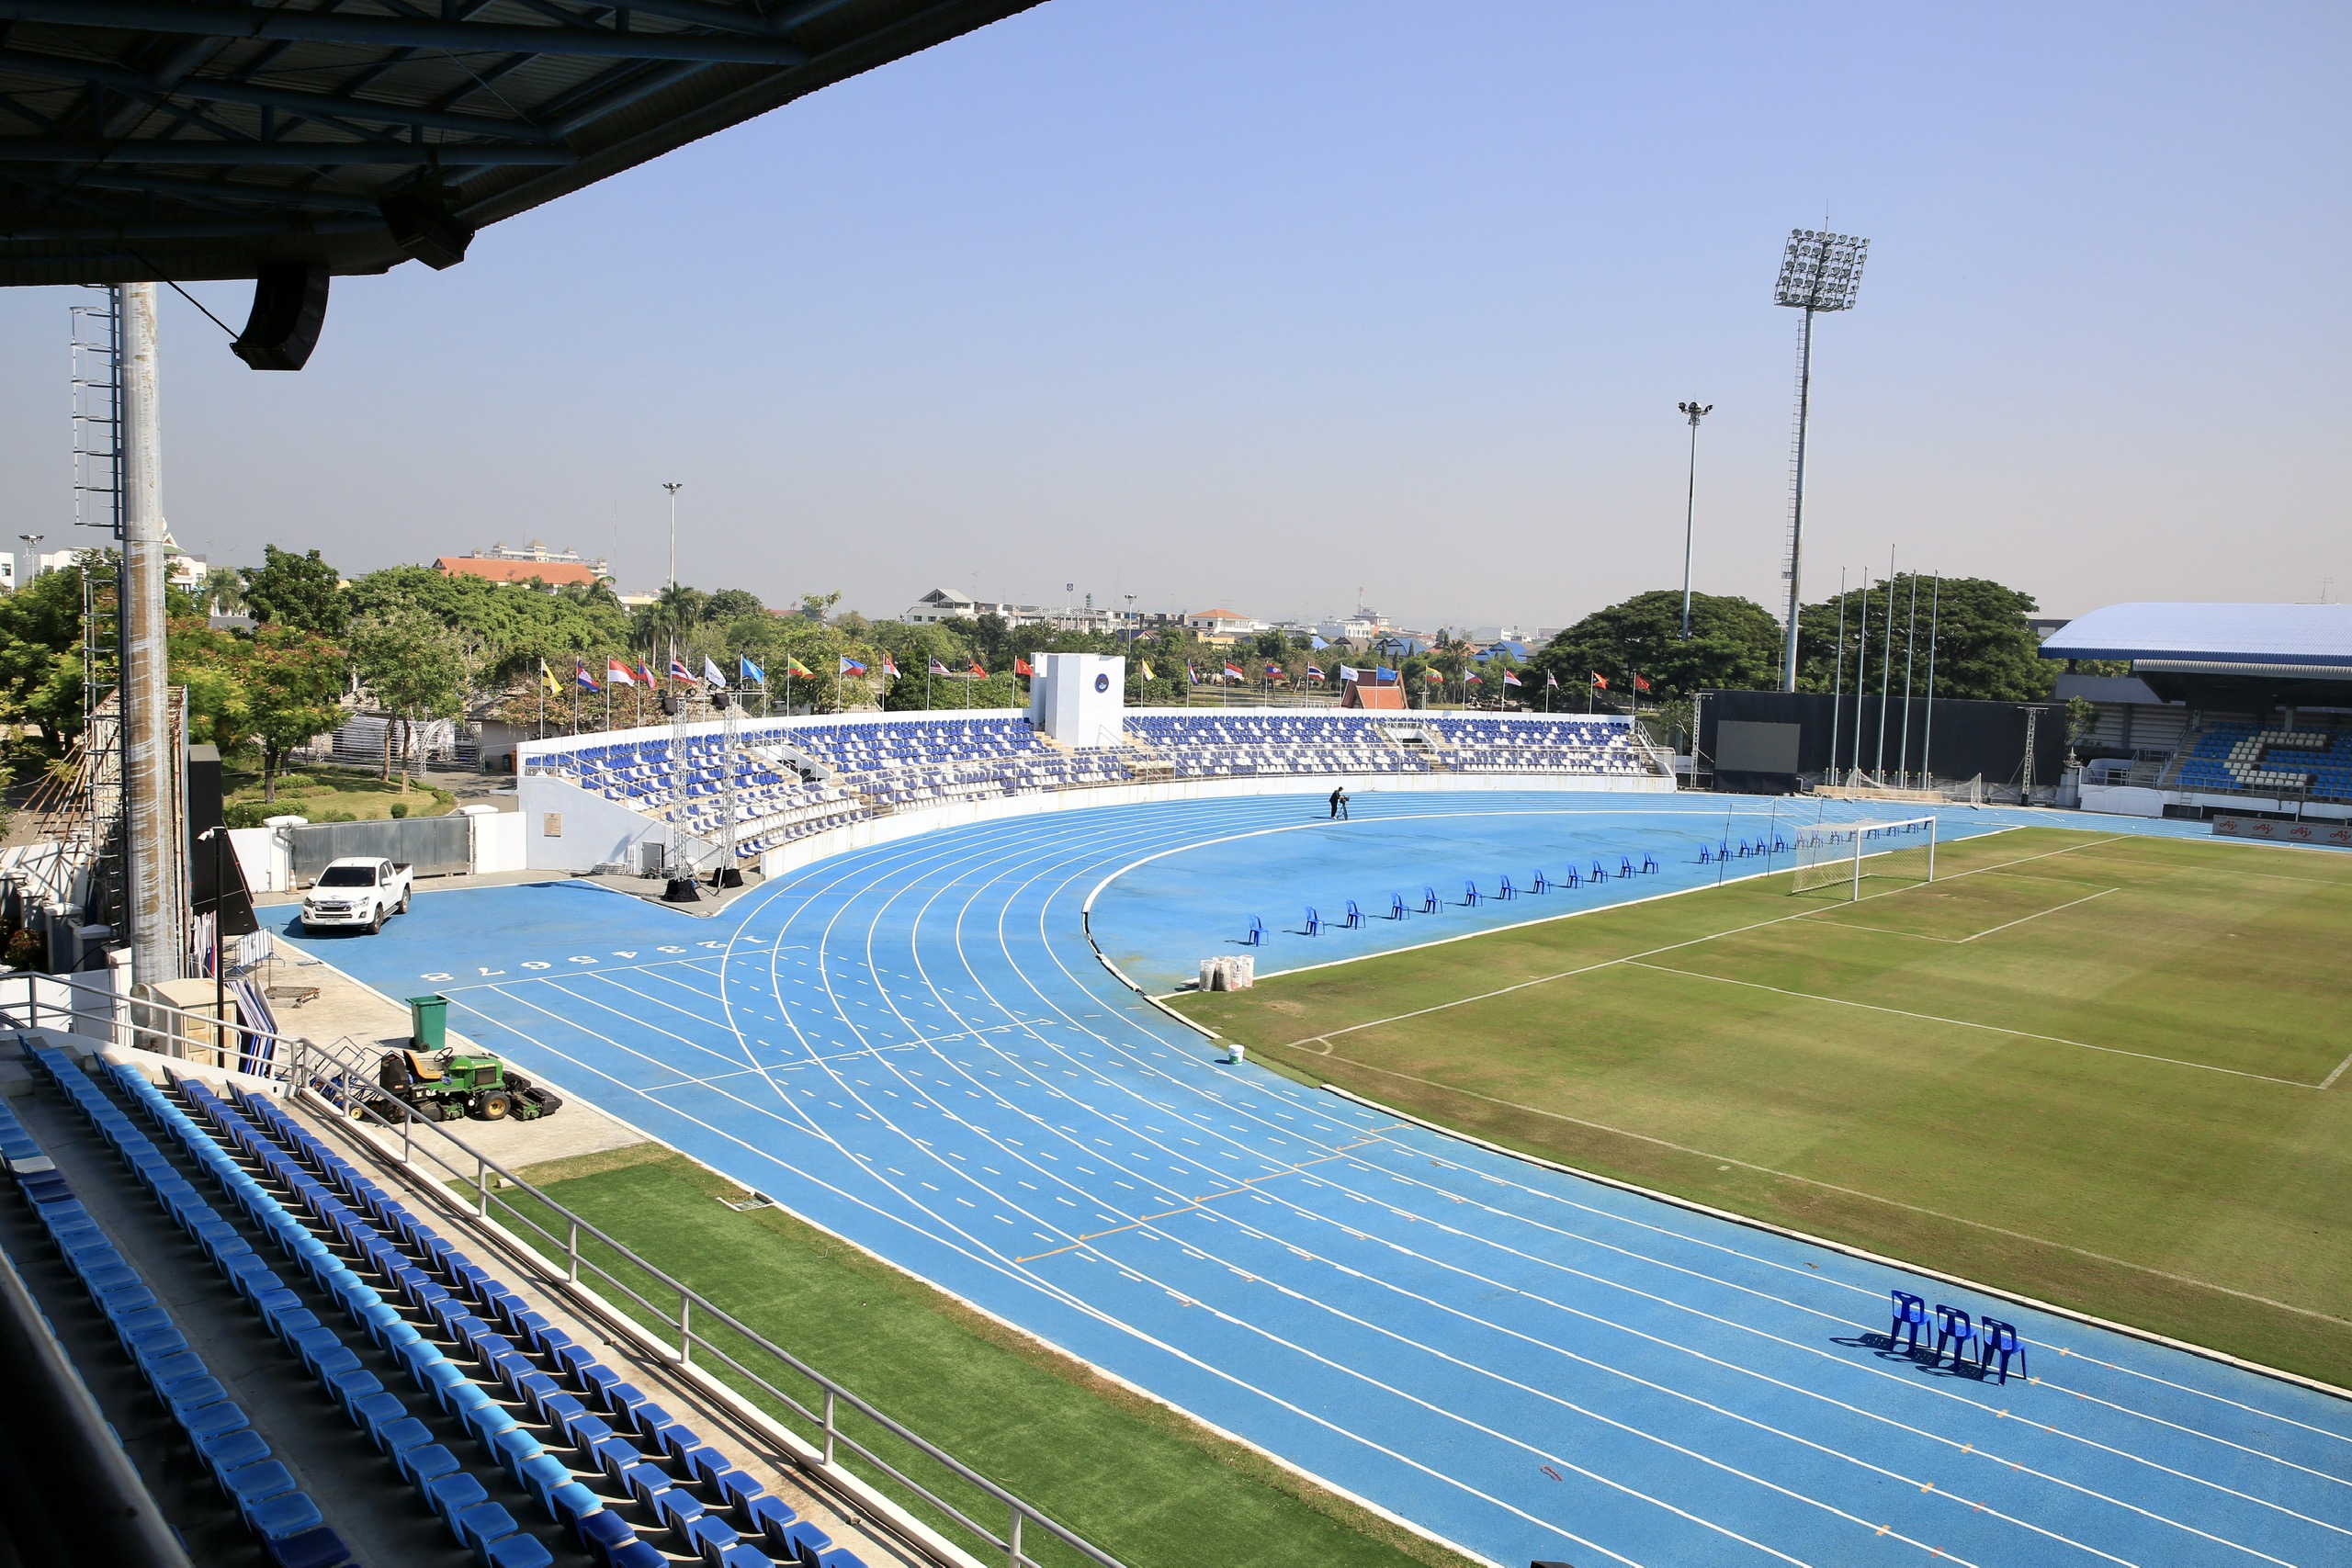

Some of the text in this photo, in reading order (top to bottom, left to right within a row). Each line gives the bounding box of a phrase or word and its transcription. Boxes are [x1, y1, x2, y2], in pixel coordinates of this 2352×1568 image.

[420, 935, 769, 982] 1 2 3 4 5 6 7 8
